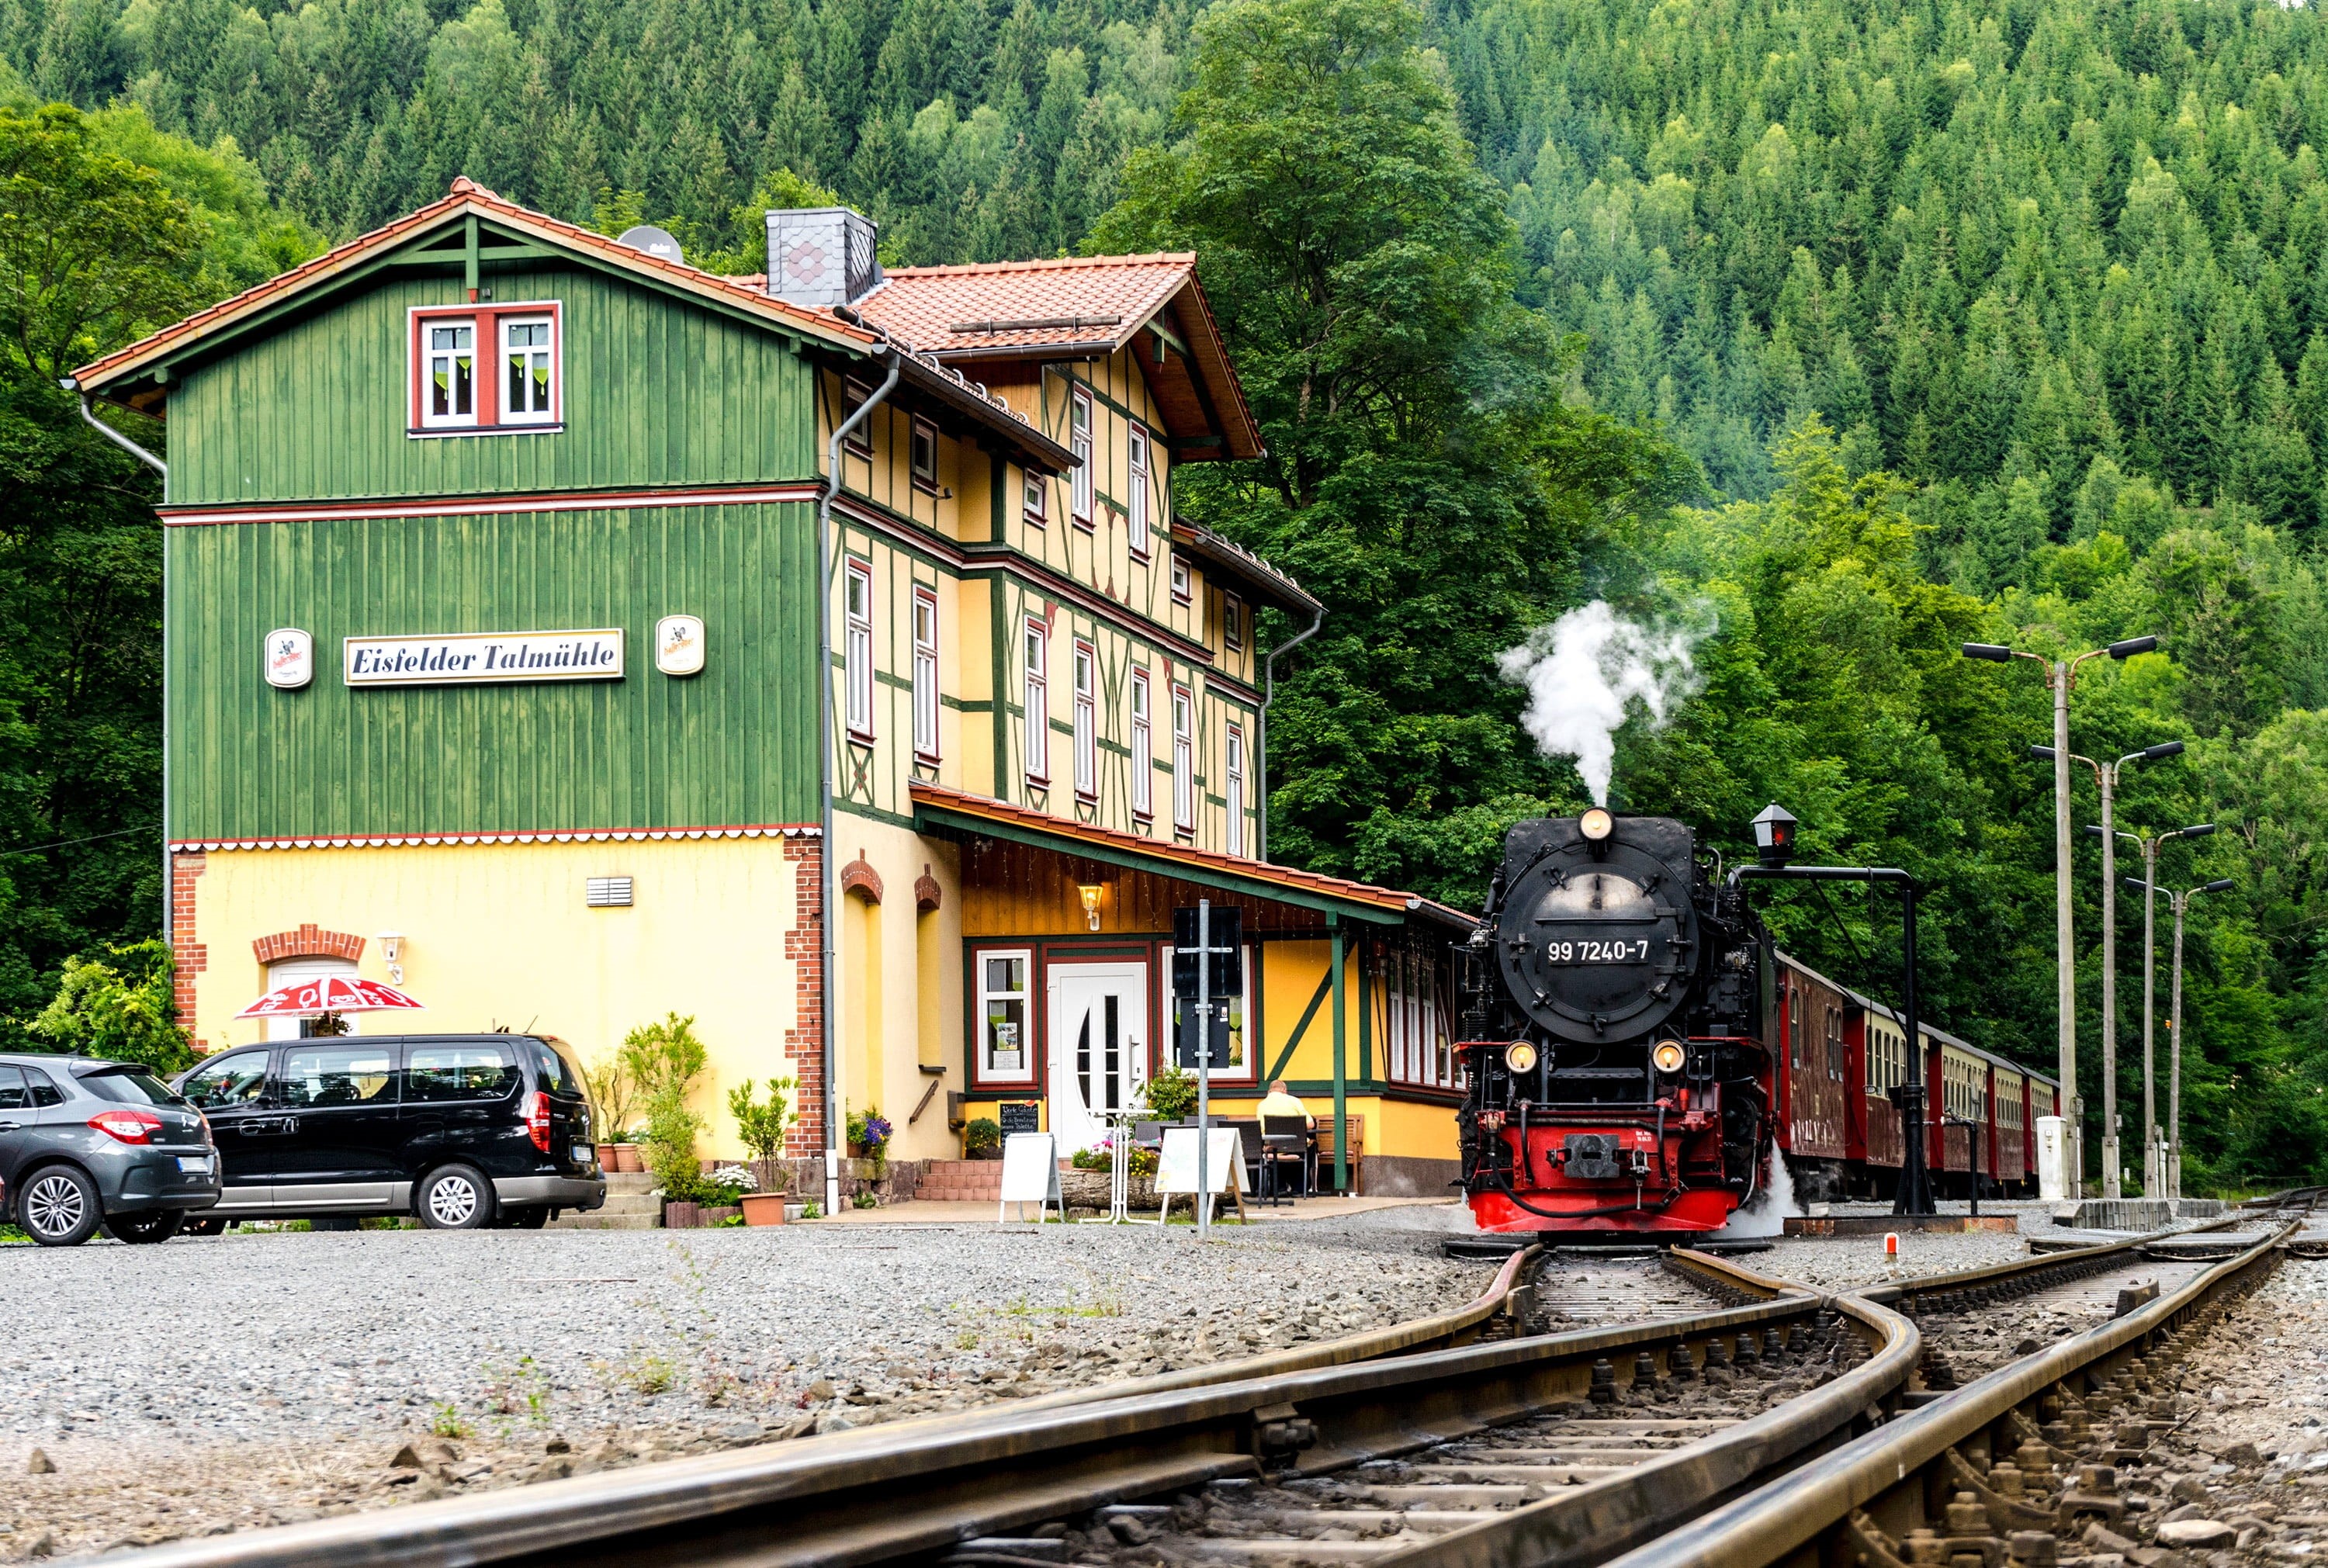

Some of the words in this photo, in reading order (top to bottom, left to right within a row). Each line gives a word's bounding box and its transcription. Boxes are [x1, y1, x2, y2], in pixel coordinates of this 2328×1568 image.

[352, 646, 476, 674] Eisfelder
[483, 641, 615, 670] Talmühle
[1548, 942, 1572, 961] 99
[1577, 940, 1649, 961] 7240-7
